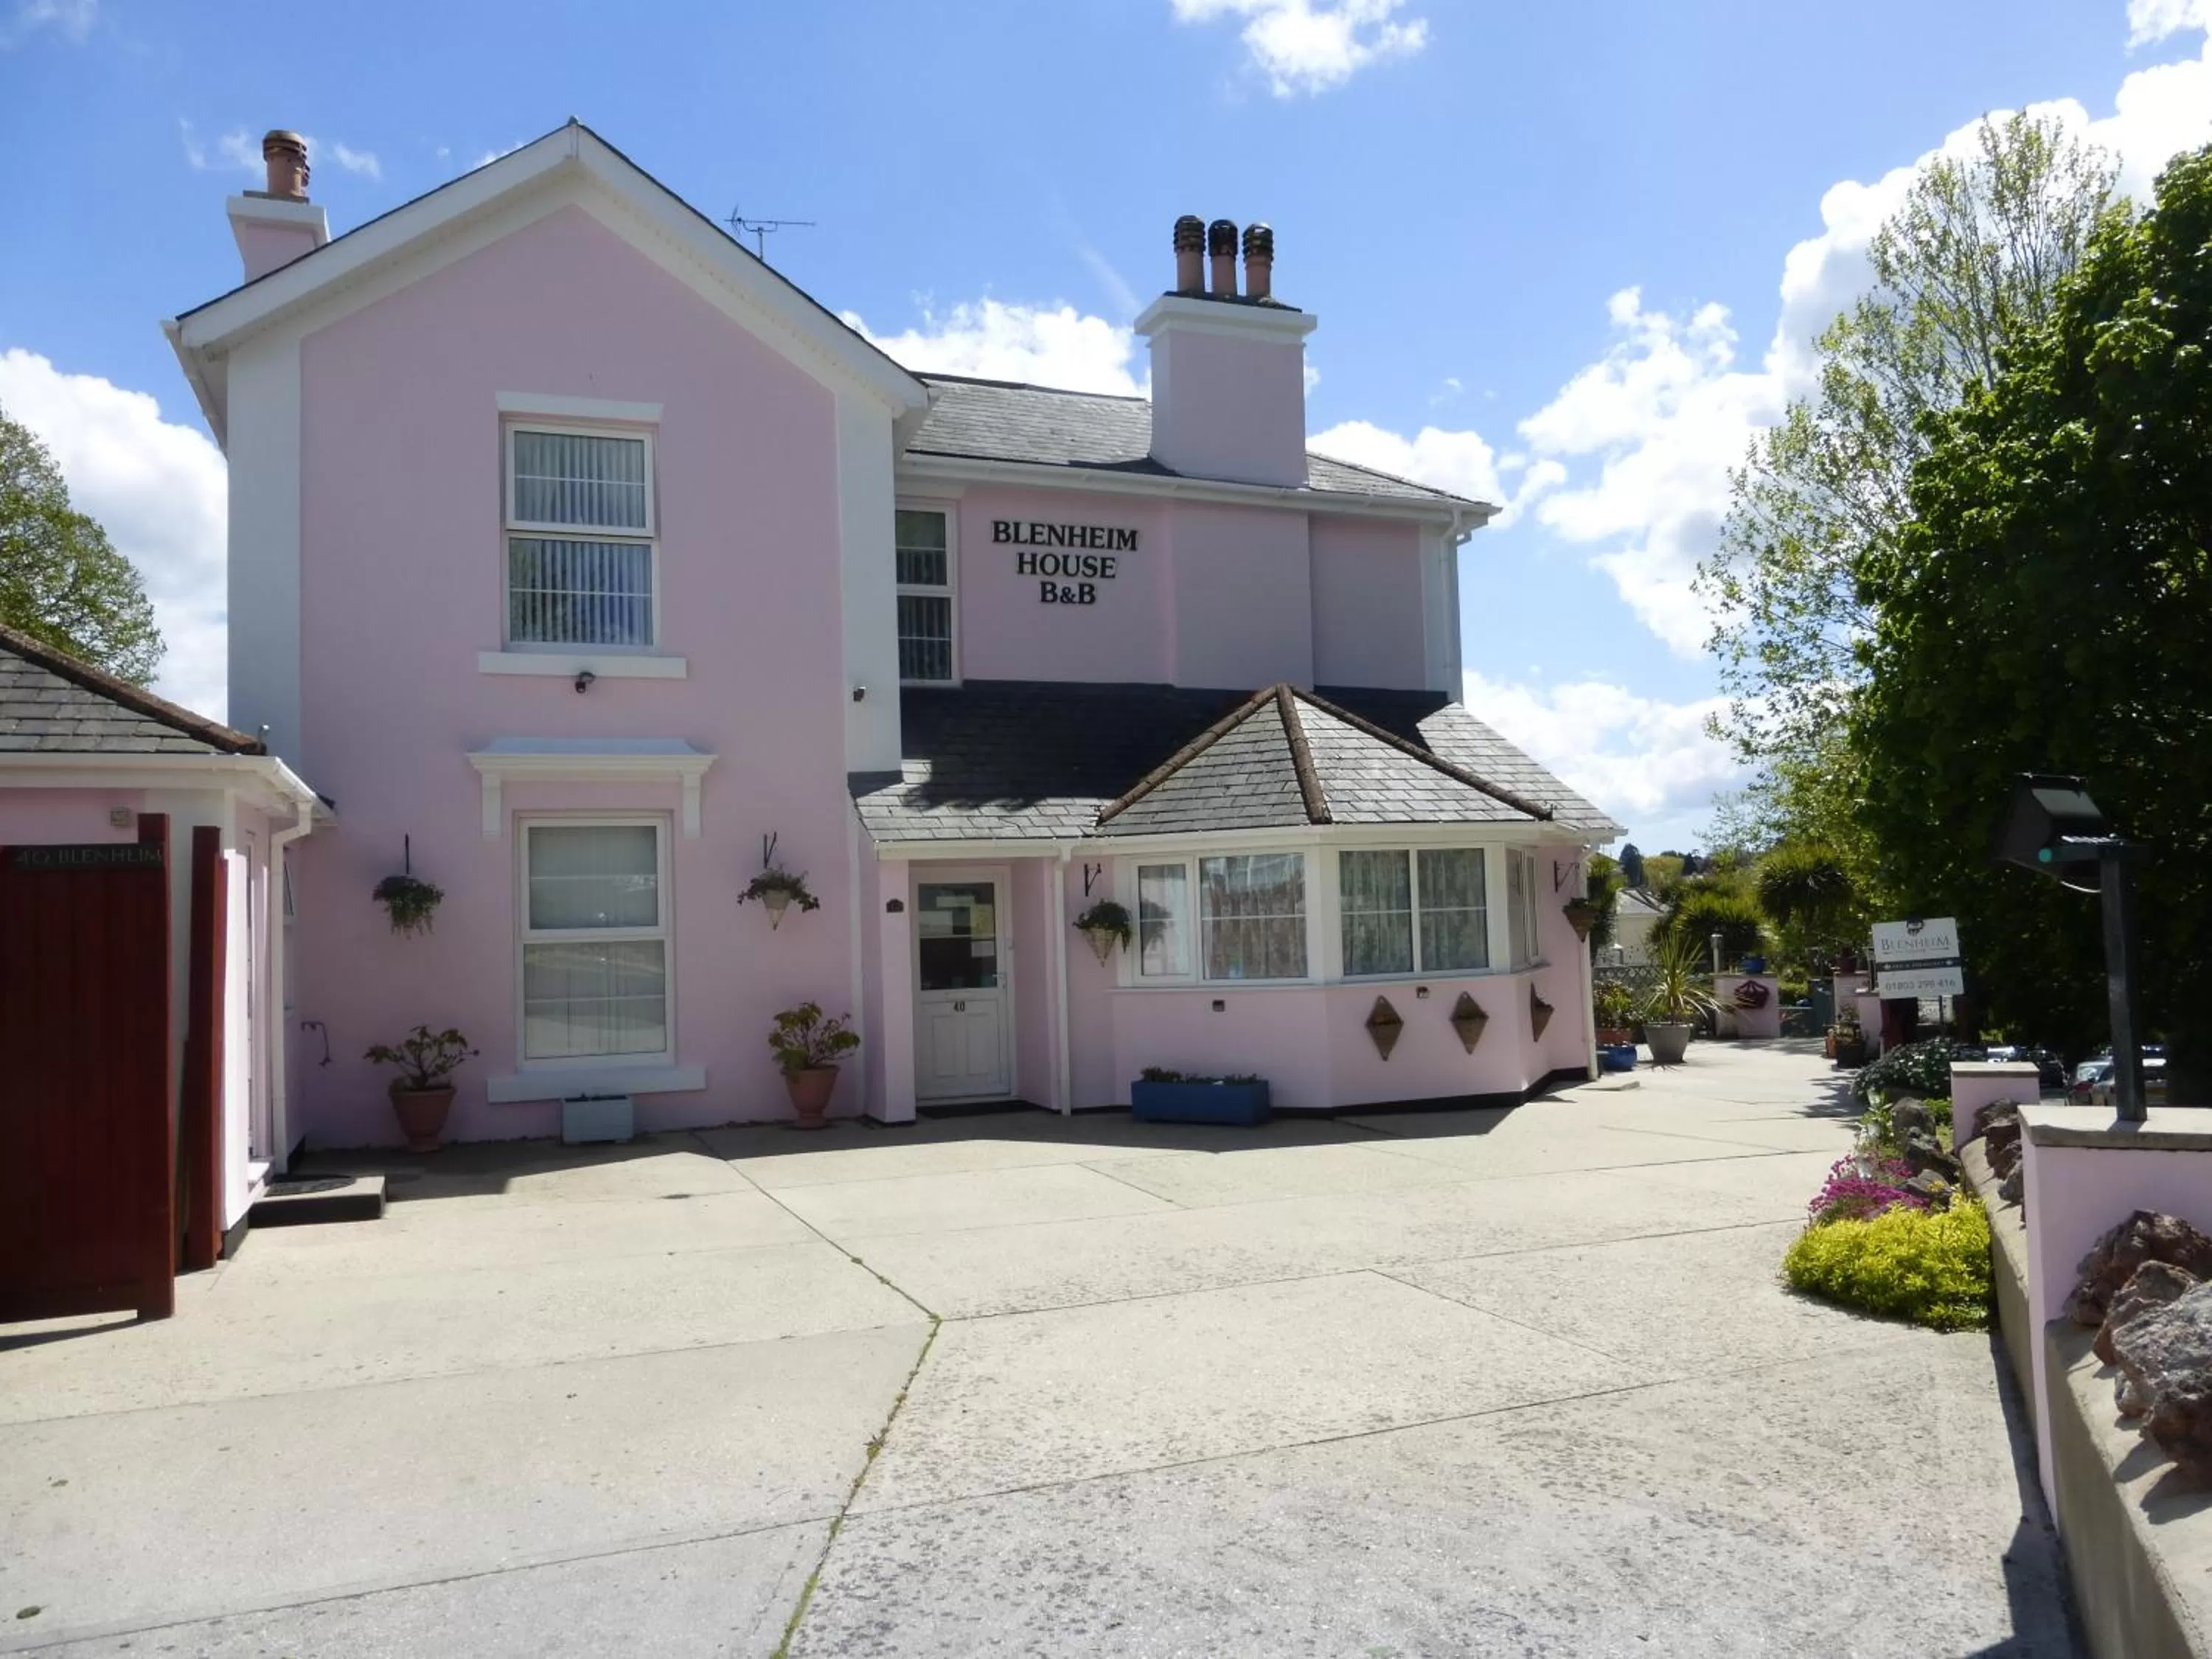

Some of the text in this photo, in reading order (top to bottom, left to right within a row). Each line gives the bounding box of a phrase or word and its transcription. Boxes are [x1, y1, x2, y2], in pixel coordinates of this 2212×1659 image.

[992, 521, 1138, 551] BLENHEIM
[1017, 552, 1116, 579] HOUSE
[1040, 581, 1097, 605] B&B
[1881, 936, 1950, 951] BLENHEIM
